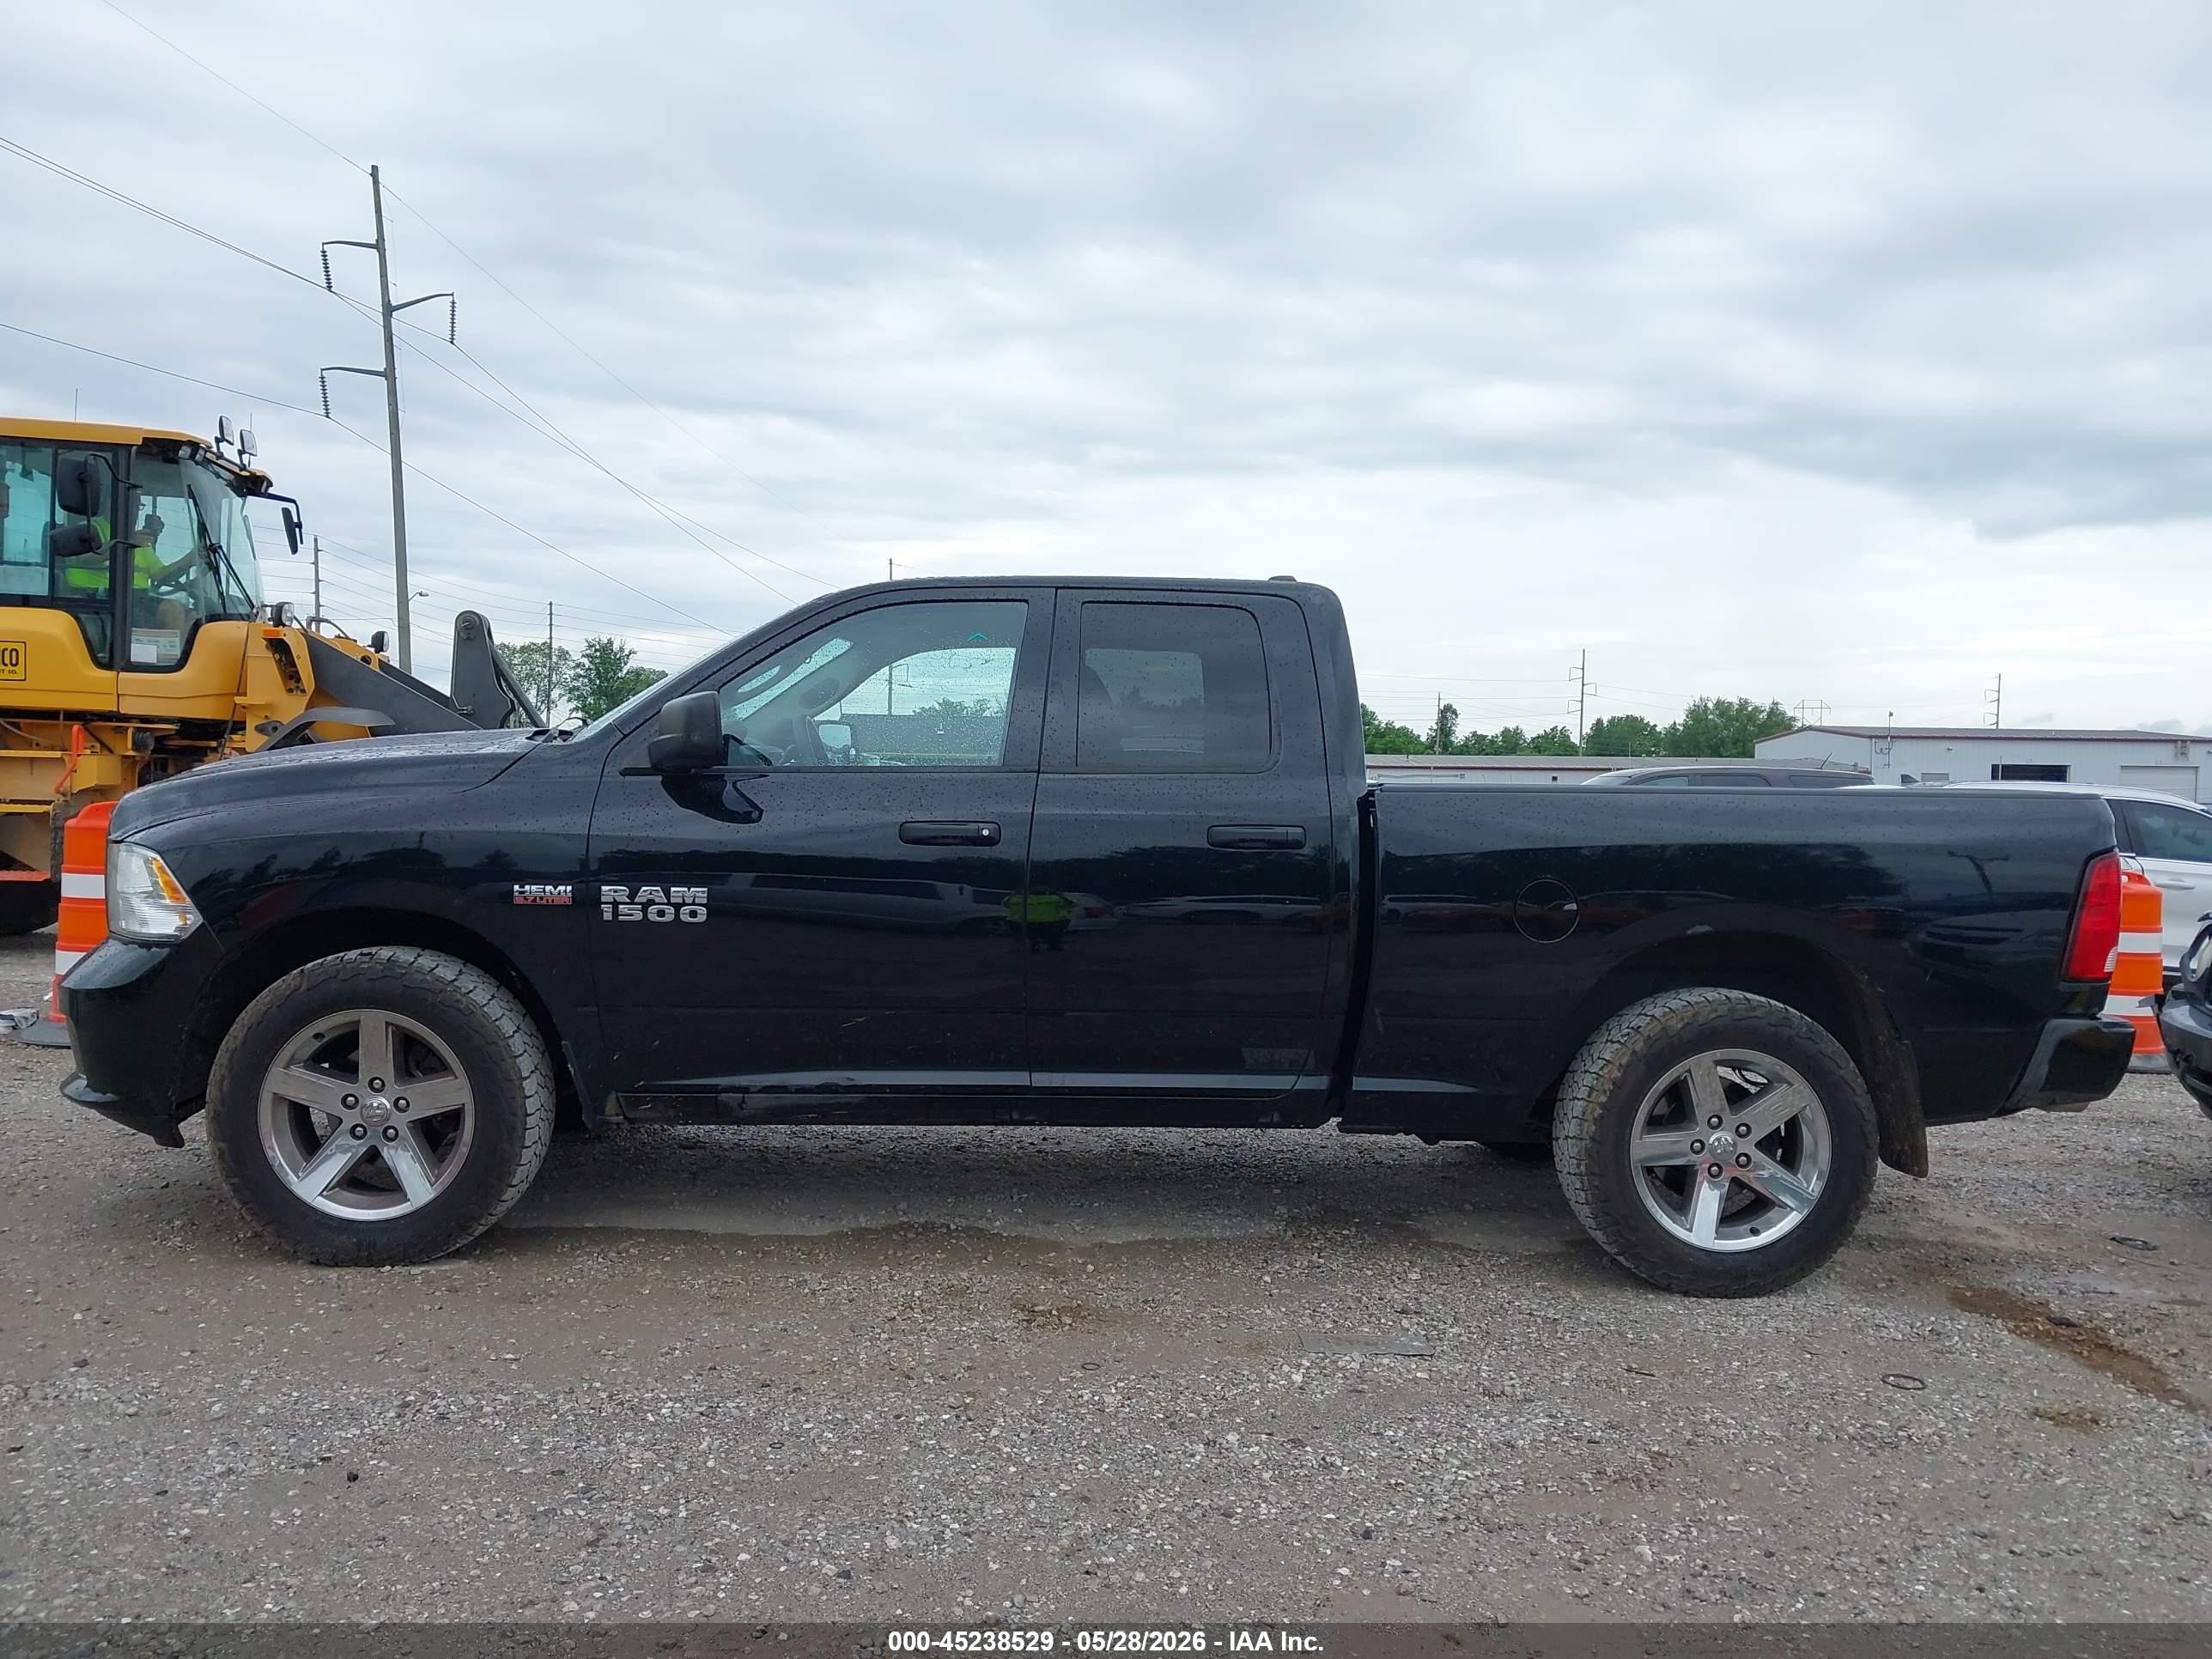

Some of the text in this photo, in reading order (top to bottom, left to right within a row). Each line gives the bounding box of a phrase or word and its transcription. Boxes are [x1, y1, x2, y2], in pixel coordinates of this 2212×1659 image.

[0, 647, 19, 667] CO
[513, 884, 573, 896] HEMI
[601, 885, 708, 903] RAM
[601, 904, 707, 922] 1500
